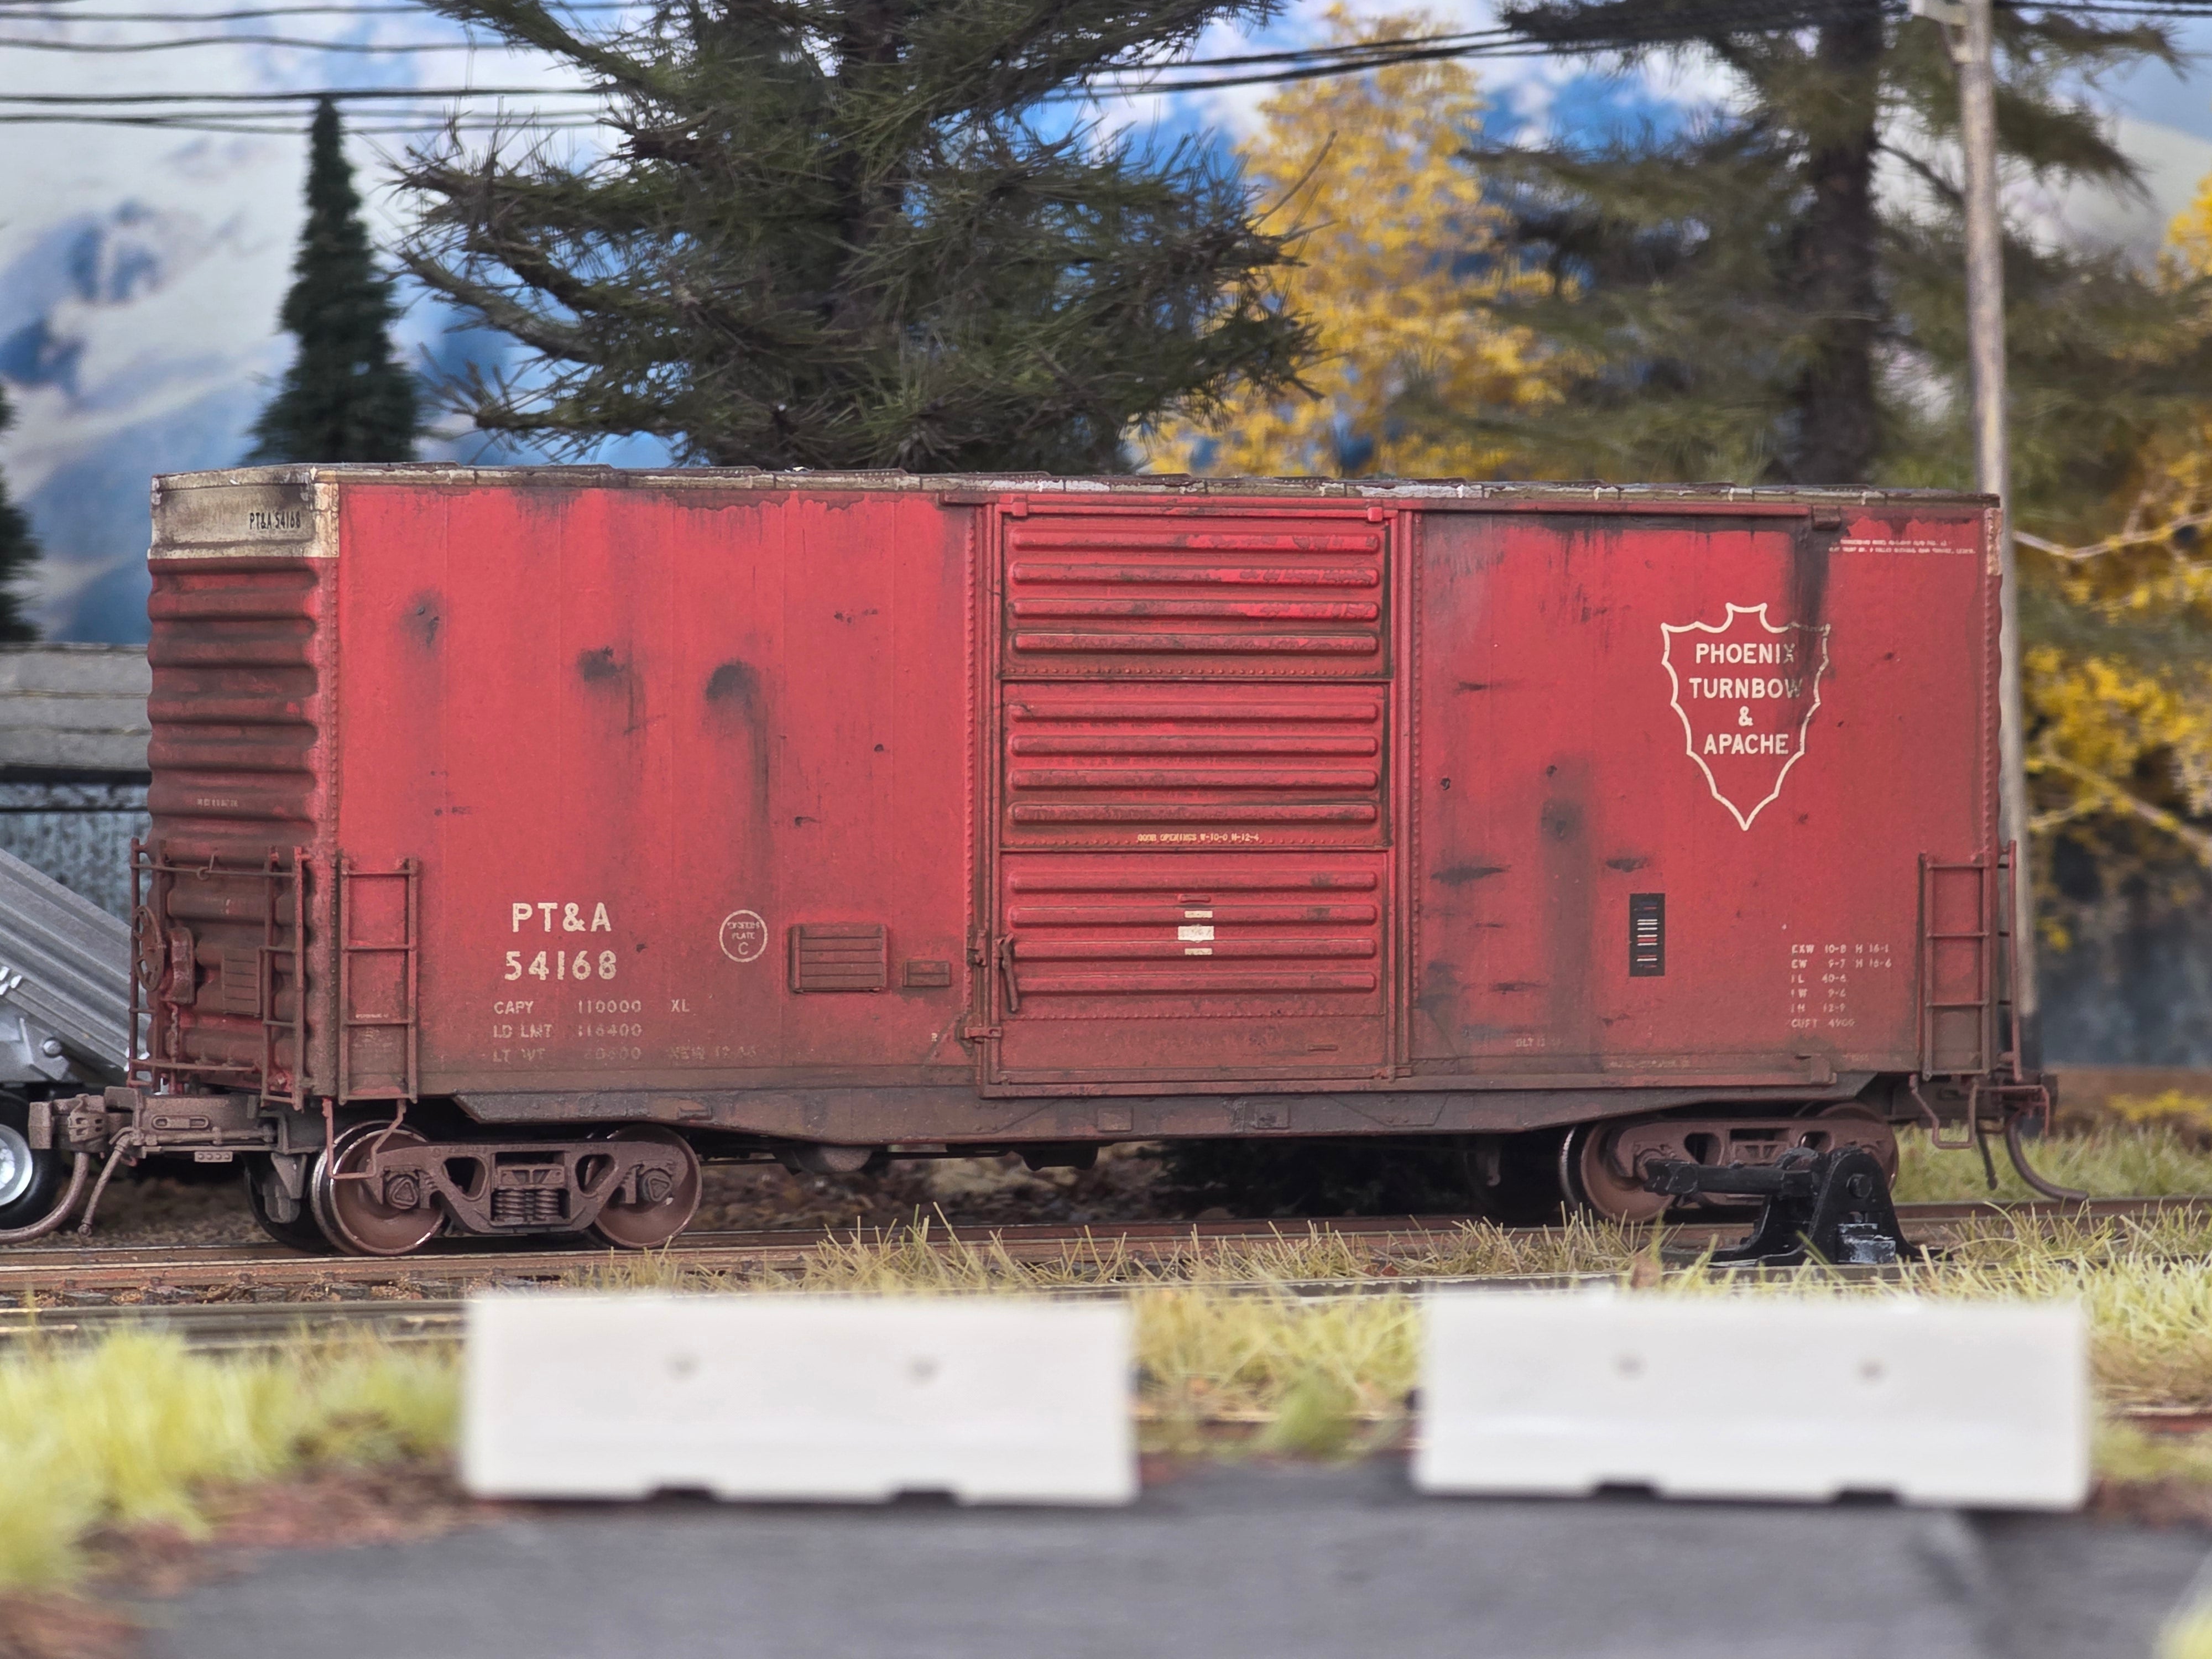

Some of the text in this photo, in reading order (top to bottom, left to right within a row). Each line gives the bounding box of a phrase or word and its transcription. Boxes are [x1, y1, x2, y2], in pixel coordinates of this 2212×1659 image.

[249, 510, 301, 530] PT&A 54168
[1695, 643, 1795, 664] PHOENIX
[1689, 678, 1803, 698] TURNBOW
[1738, 706, 1754, 726] &
[1704, 733, 1789, 754] APACHE
[513, 902, 612, 932] PT&A
[738, 941, 749, 955] C
[1791, 943, 1889, 954] EXW 10-8 H 16-1
[504, 950, 617, 980] 54168
[1791, 959, 1808, 969] EW
[1855, 958, 1863, 968] H
[1869, 958, 1892, 968] 16-6
[1822, 973, 1846, 983] 40-6
[493, 999, 690, 1015] CAPY 110000 XL
[493, 1024, 513, 1039] LD
